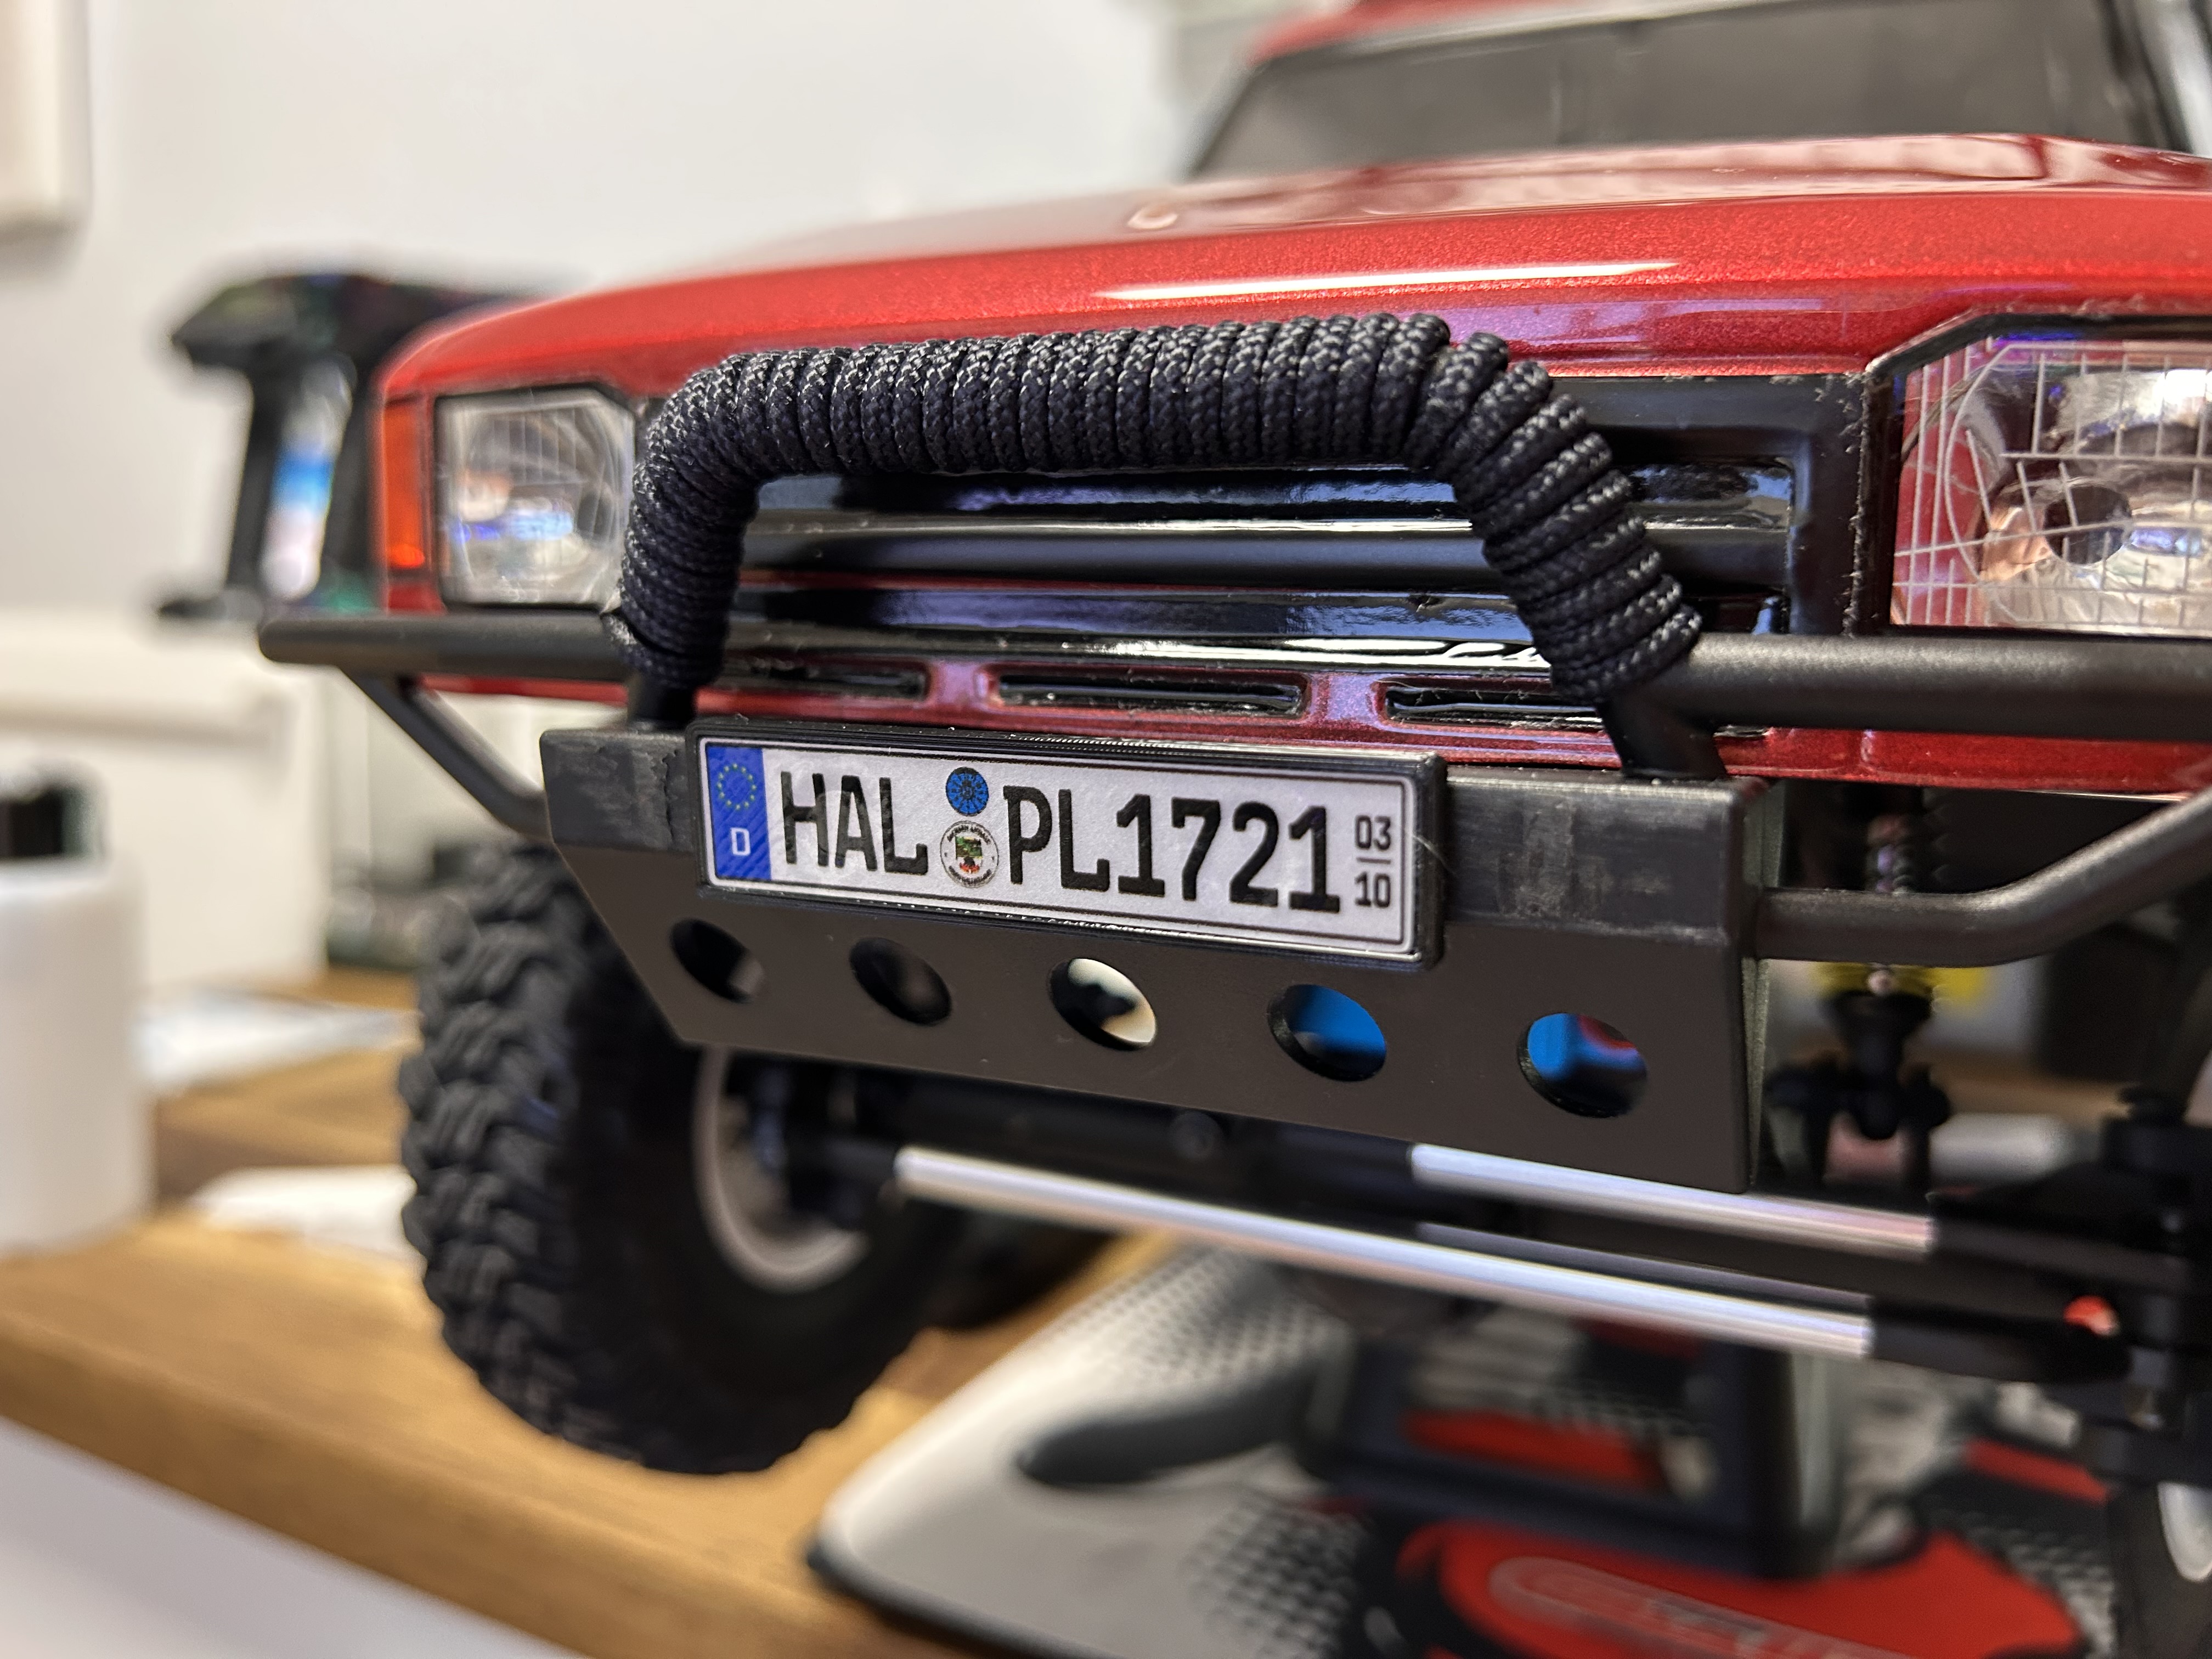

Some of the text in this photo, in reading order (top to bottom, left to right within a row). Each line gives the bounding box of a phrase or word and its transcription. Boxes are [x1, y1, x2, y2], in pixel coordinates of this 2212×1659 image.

[781, 771, 928, 875] HAL
[1355, 815, 1391, 850] 03
[730, 827, 751, 856] D
[1355, 871, 1391, 909] 10
